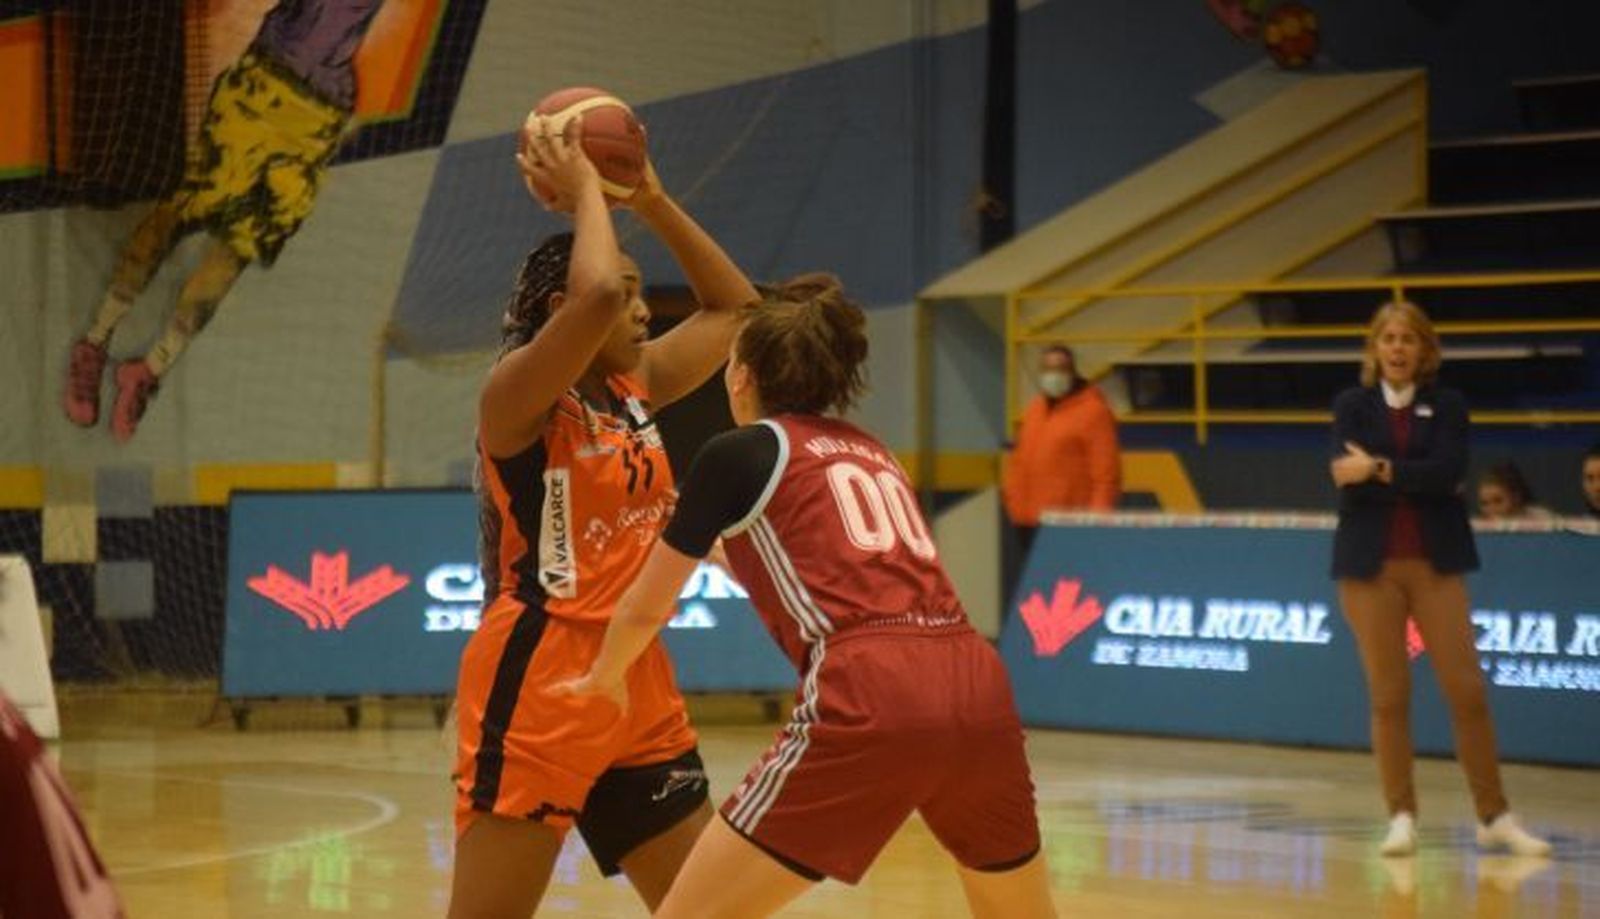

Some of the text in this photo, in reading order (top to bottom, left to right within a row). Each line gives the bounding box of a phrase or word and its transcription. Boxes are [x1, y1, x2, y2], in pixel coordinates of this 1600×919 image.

[551, 477, 568, 563] VALCARCE
[826, 461, 936, 561] 00
[1104, 596, 1332, 644] CAJA RURAL
